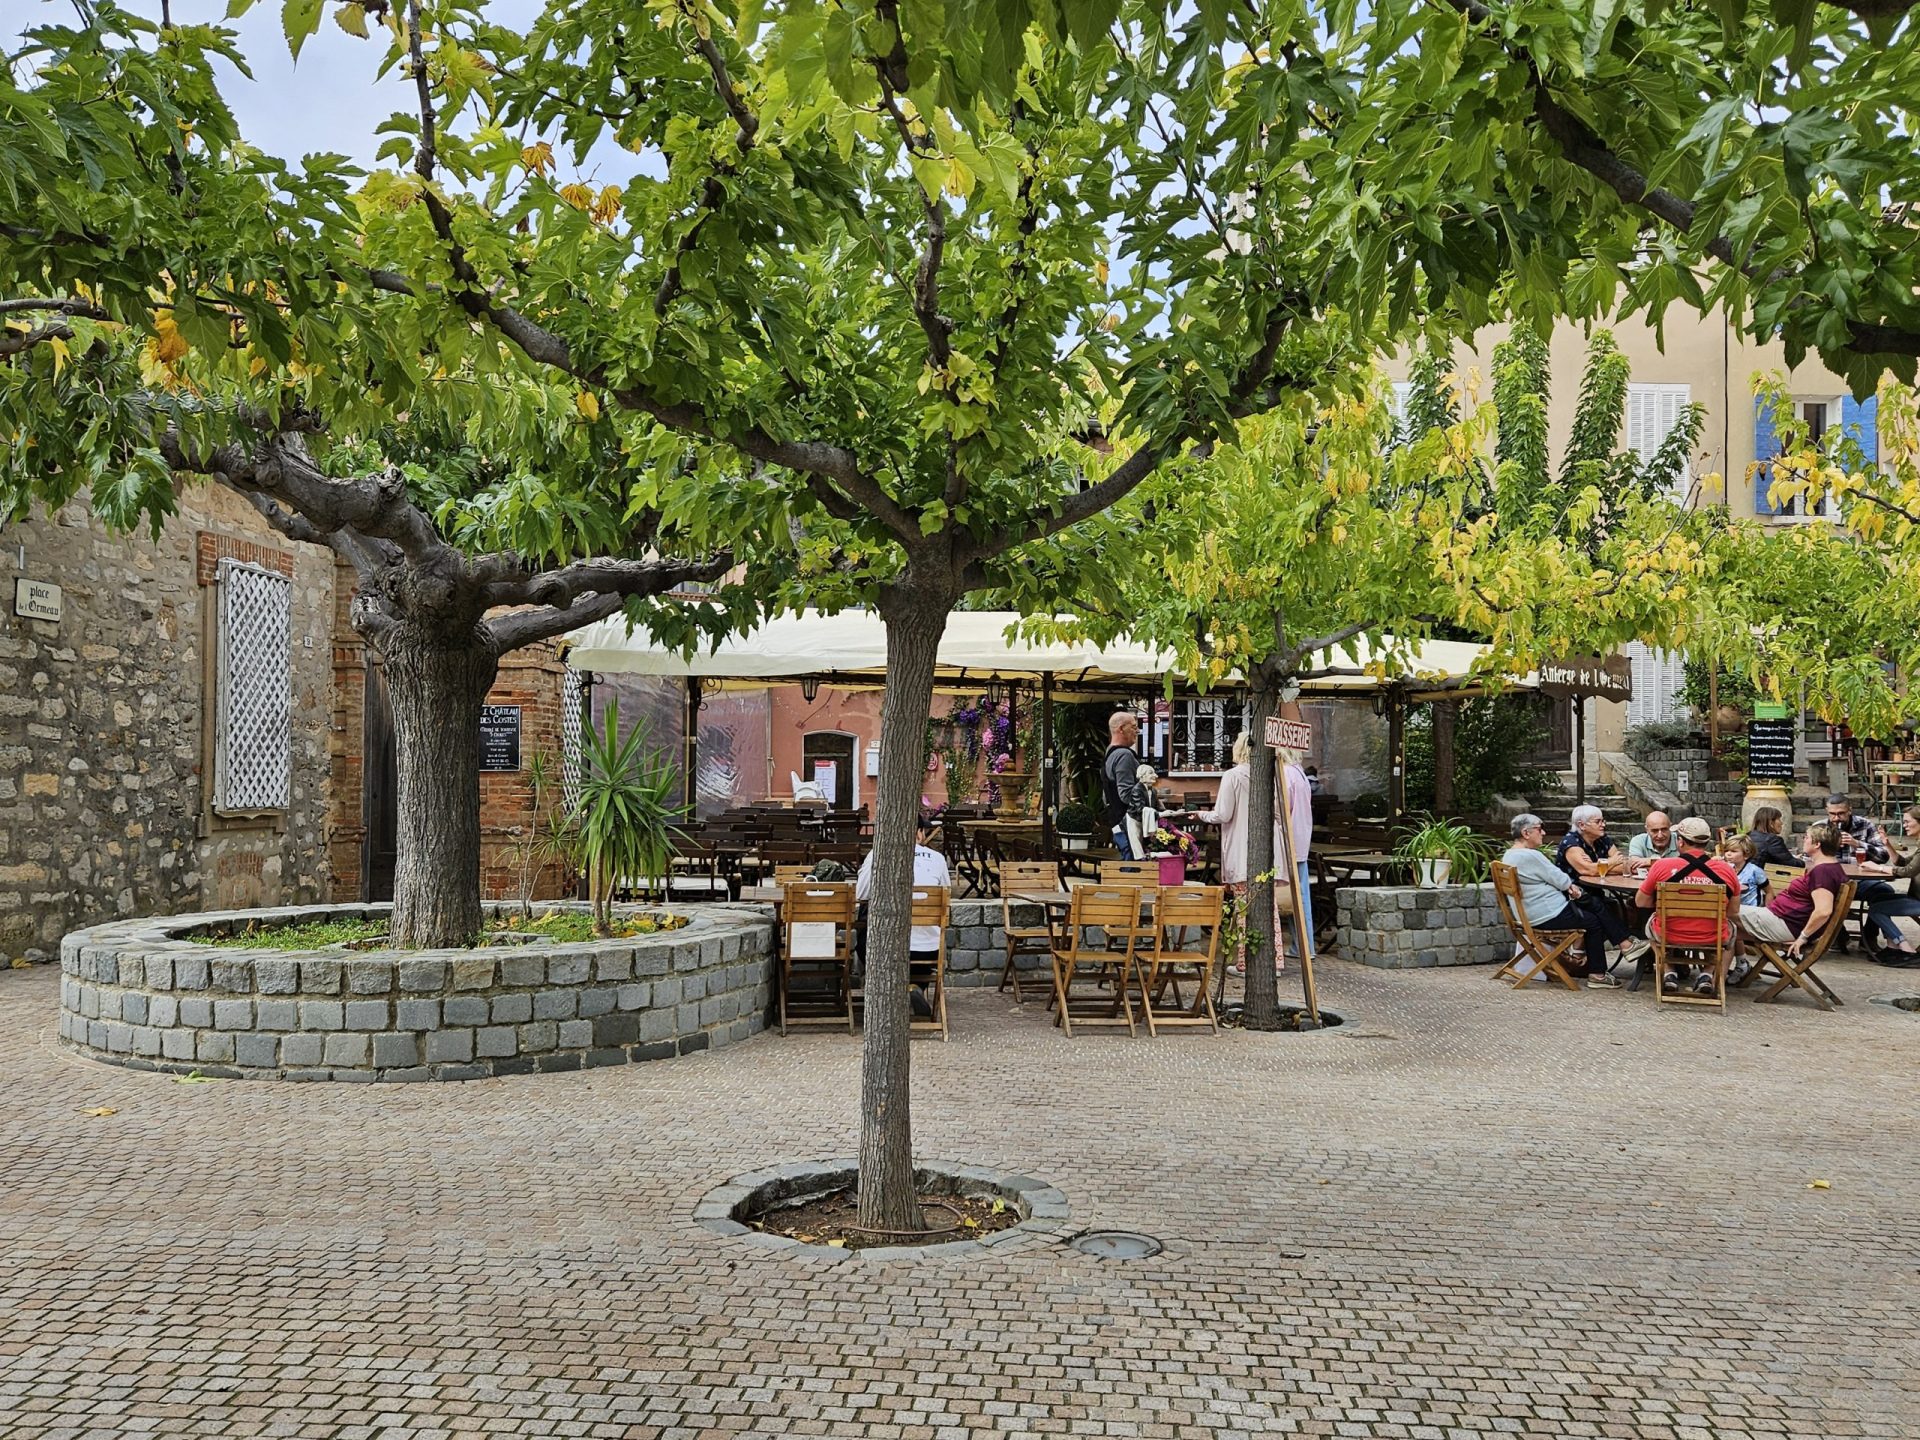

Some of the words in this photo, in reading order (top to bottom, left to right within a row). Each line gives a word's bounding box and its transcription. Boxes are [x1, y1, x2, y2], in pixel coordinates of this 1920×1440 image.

[30, 586, 49, 599] place
[1540, 664, 1576, 686] Auberge
[1580, 668, 1590, 687] de
[1266, 719, 1310, 749] BRASSERIE
